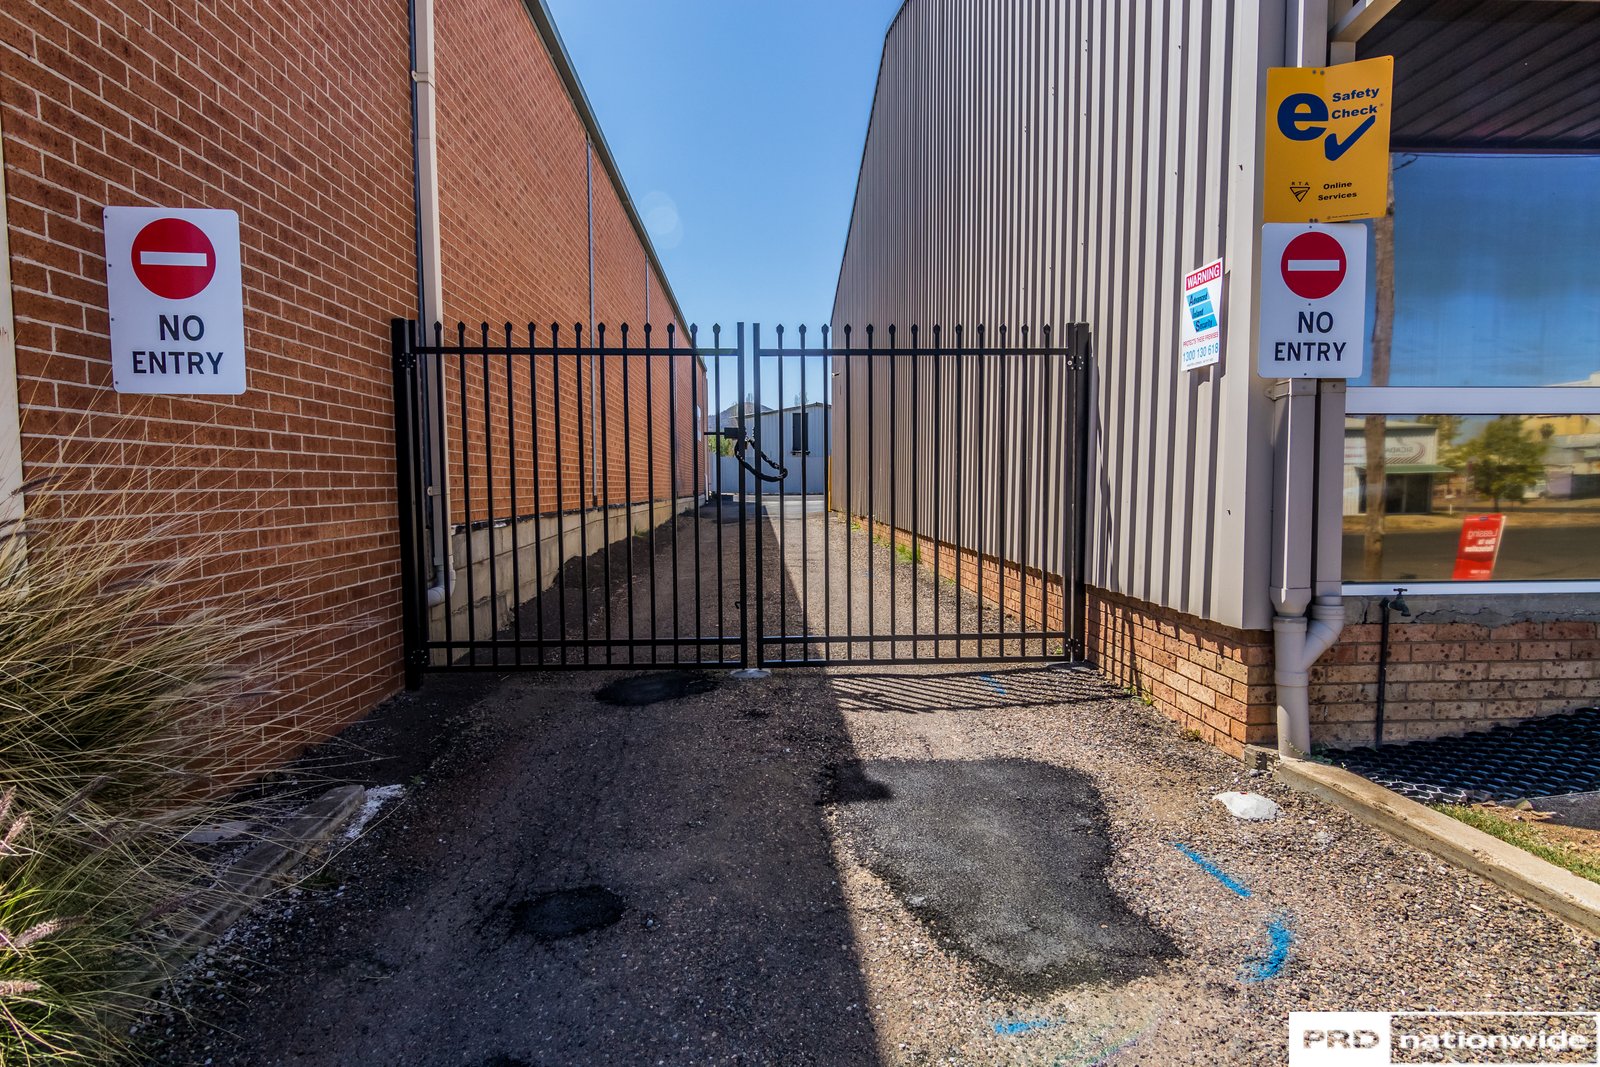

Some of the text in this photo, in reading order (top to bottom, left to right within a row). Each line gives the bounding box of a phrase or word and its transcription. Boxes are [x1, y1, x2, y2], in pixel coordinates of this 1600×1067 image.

[1332, 88, 1380, 102] Safety
[1277, 93, 1328, 141] e
[1331, 104, 1378, 120] Check
[1318, 191, 1358, 201] Services
[1323, 181, 1353, 190] Online
[1187, 264, 1220, 289] WARNING
[158, 314, 205, 341] NO
[1298, 311, 1334, 334] NO
[1183, 350, 1196, 363] 1300
[1197, 346, 1207, 359] 130
[1208, 342, 1219, 355] 618
[1274, 342, 1347, 361] ENTRY
[132, 350, 224, 375] ENTRY
